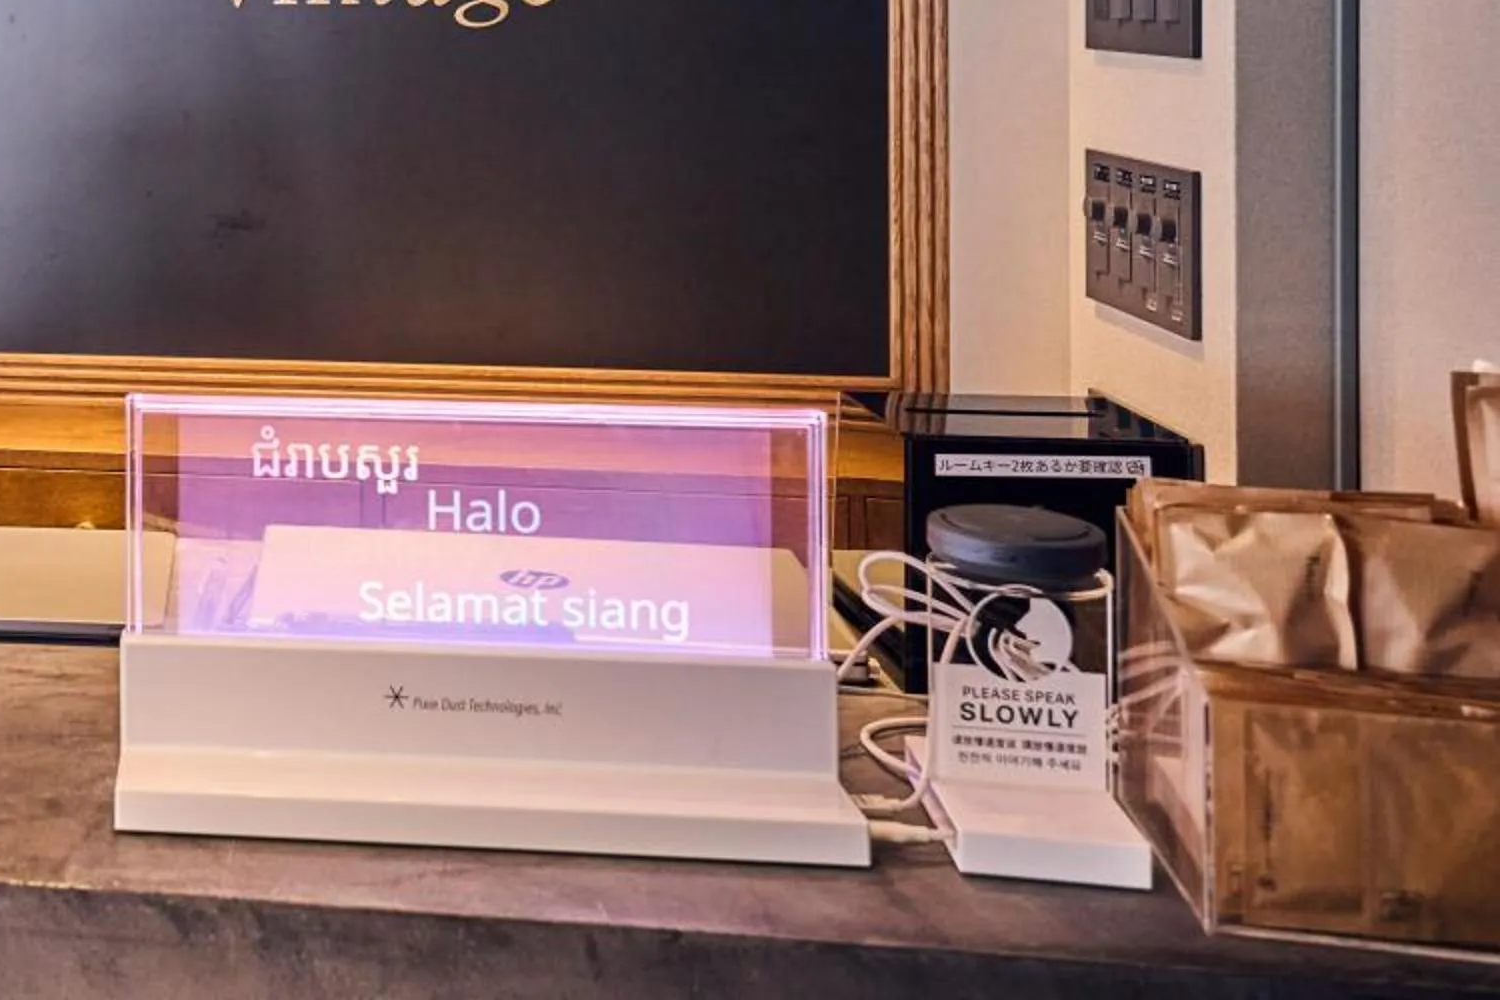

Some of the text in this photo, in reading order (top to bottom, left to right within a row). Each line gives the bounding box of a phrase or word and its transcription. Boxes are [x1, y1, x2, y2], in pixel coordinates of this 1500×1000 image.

[427, 489, 542, 534] Halo
[357, 579, 691, 643] Selamat siang
[440, 697, 466, 712] Dust
[962, 685, 1076, 705] PLEASE SPEAK
[960, 701, 1079, 728] SLOWLY
